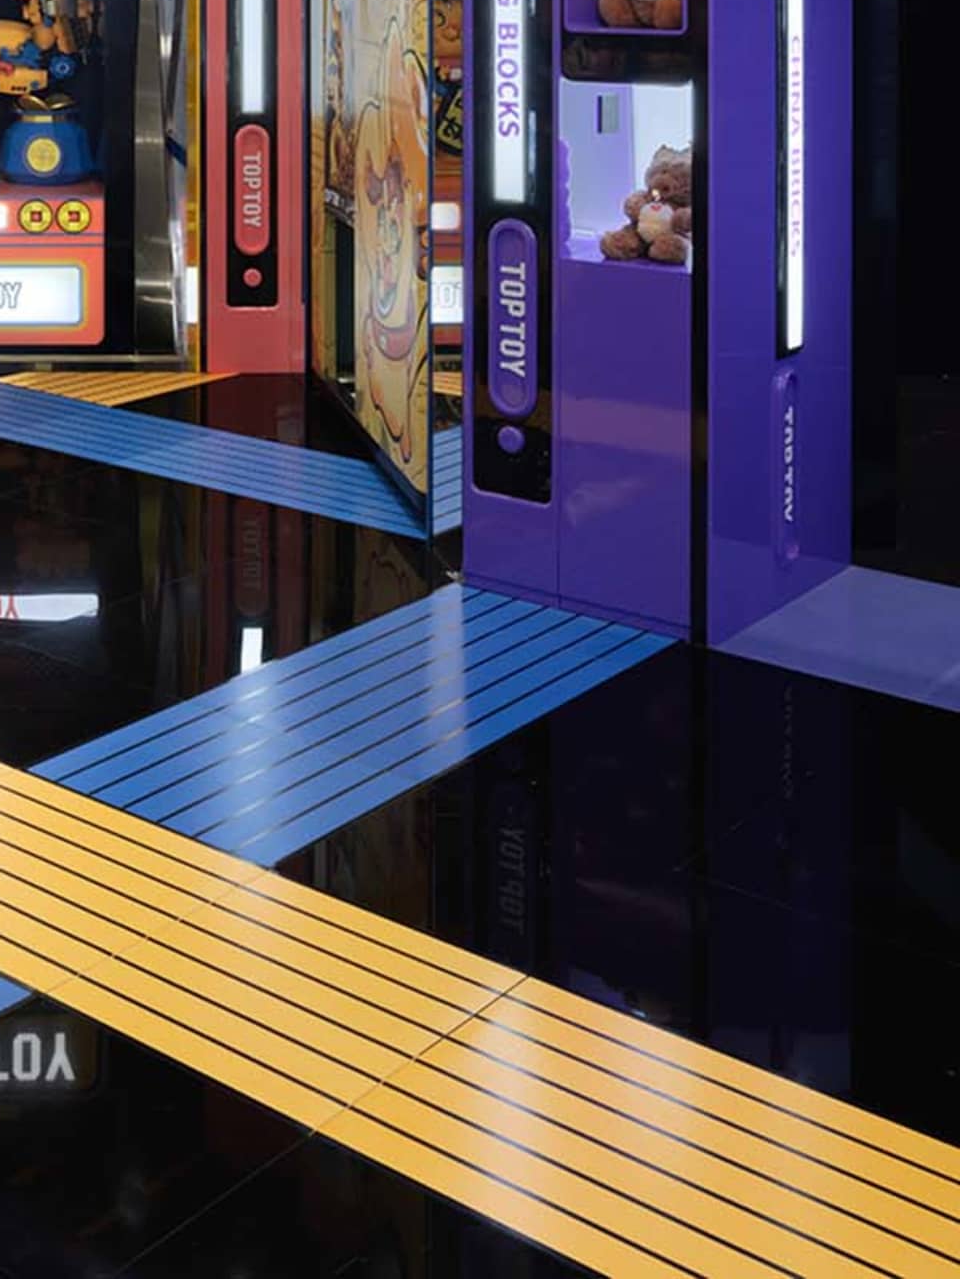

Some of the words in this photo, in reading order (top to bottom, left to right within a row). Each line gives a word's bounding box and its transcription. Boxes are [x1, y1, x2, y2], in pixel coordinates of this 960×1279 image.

[497, 24, 520, 138] BLOCKS
[243, 151, 261, 189] TOP
[243, 191, 261, 227] TOY
[500, 261, 526, 321] TOP
[500, 323, 526, 379] TOY
